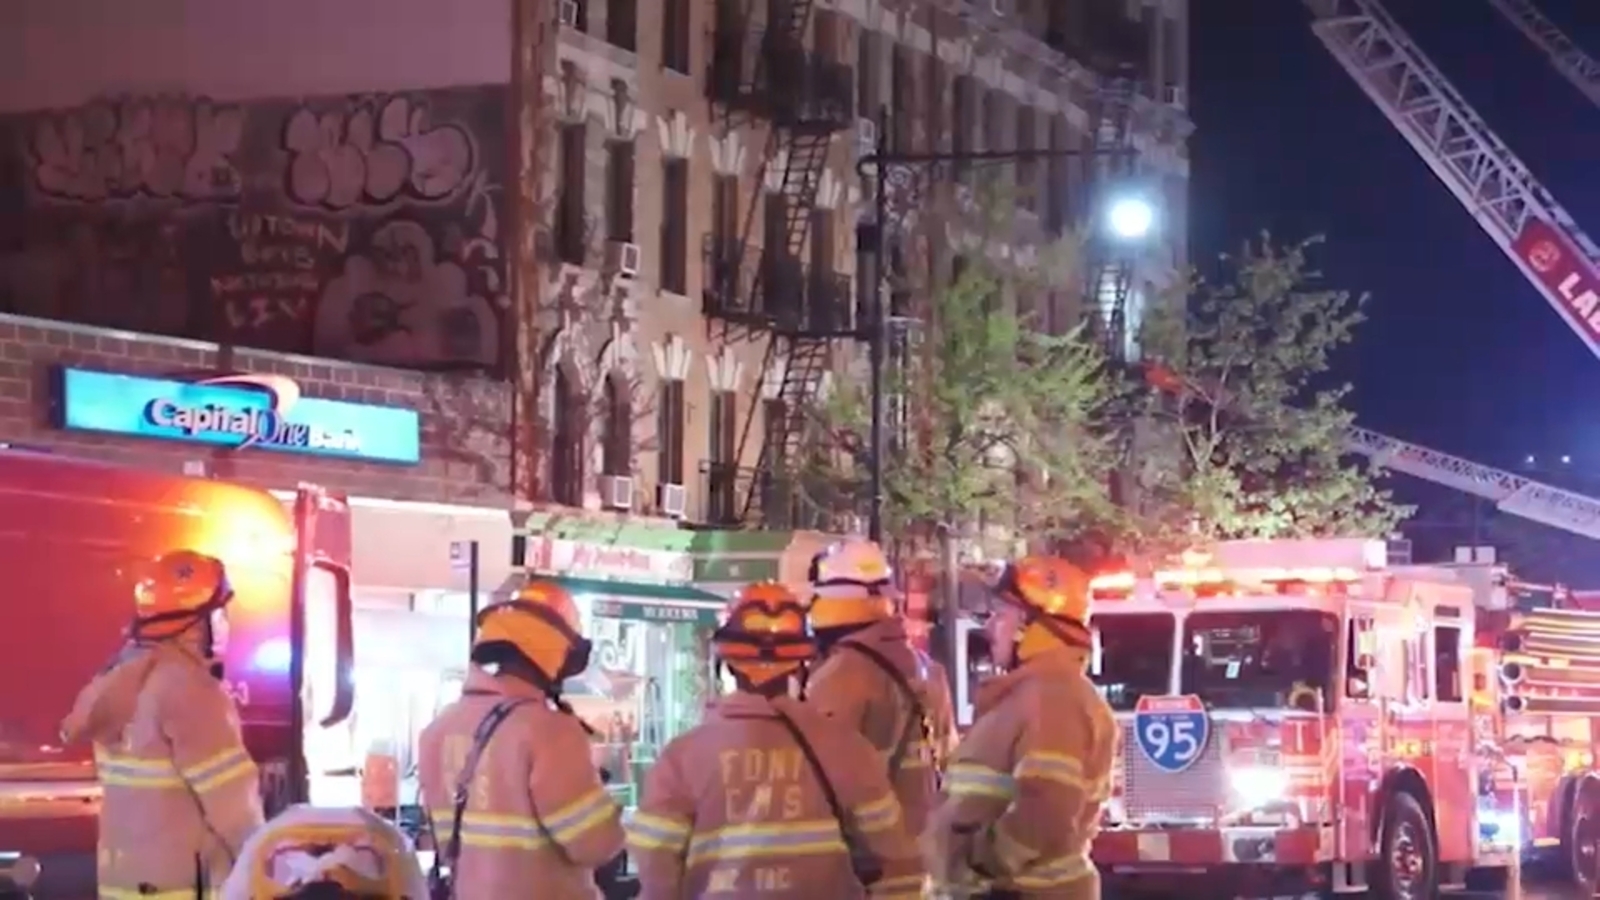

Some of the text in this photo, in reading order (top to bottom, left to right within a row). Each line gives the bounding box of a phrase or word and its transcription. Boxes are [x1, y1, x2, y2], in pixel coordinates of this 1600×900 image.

[147, 397, 257, 435] Capital
[257, 408, 308, 444] One
[1145, 720, 1198, 760] 95
